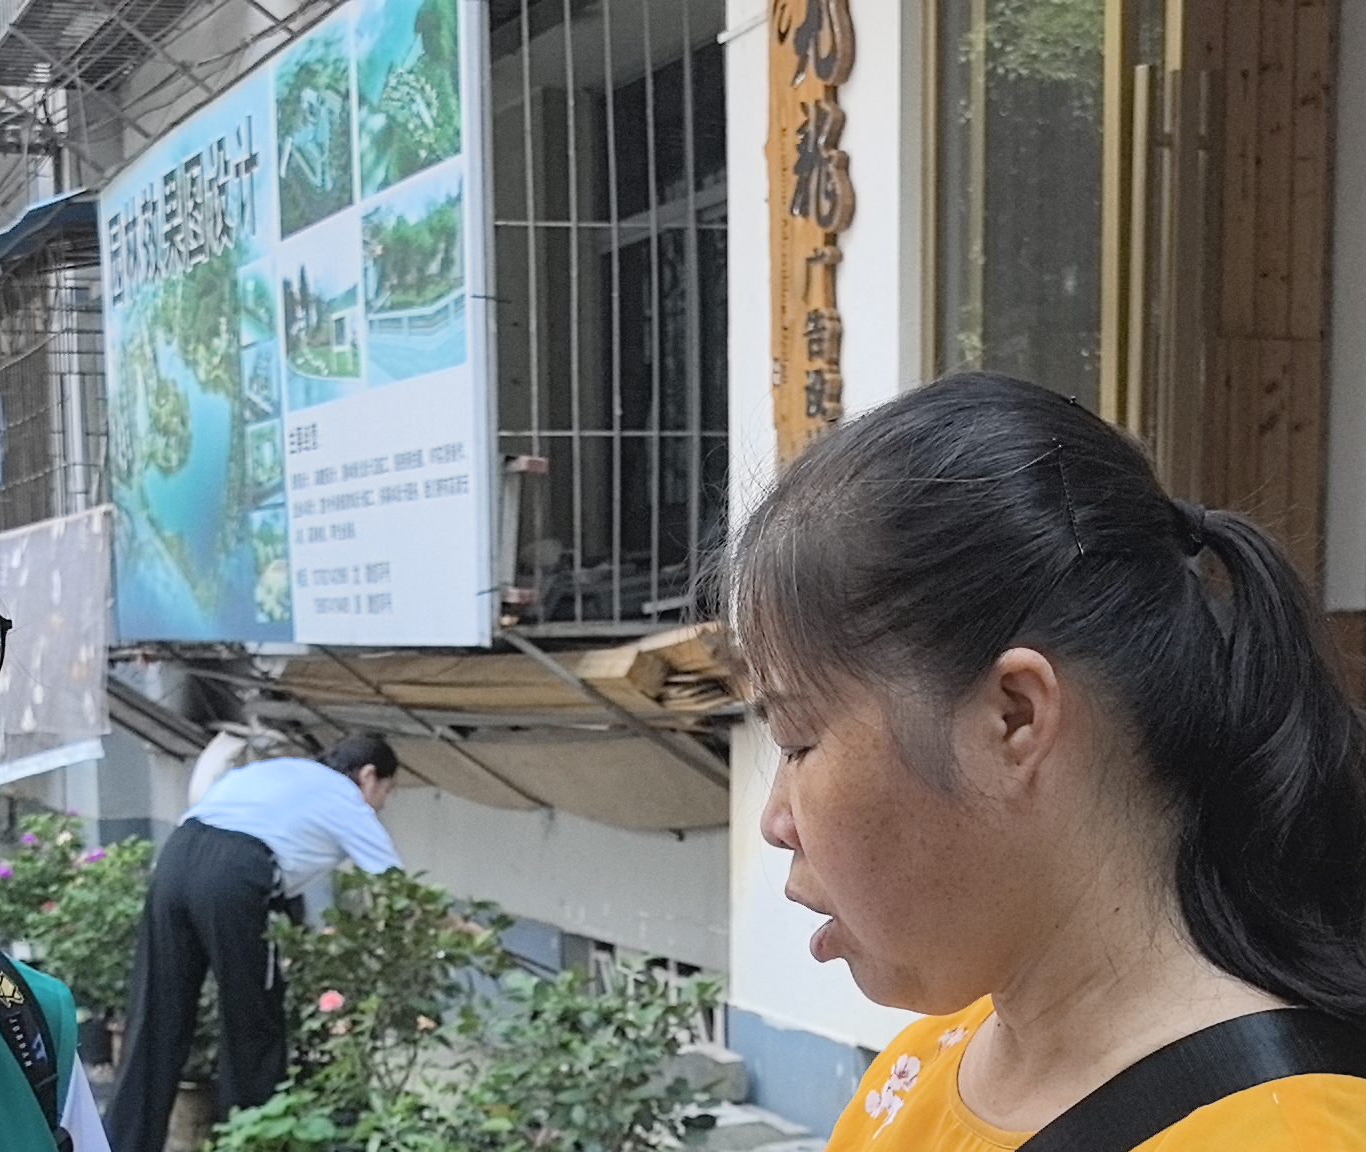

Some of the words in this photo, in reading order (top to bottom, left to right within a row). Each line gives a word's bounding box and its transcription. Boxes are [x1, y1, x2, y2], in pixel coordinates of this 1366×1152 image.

[107, 115, 263, 307] 园林效果图设计
